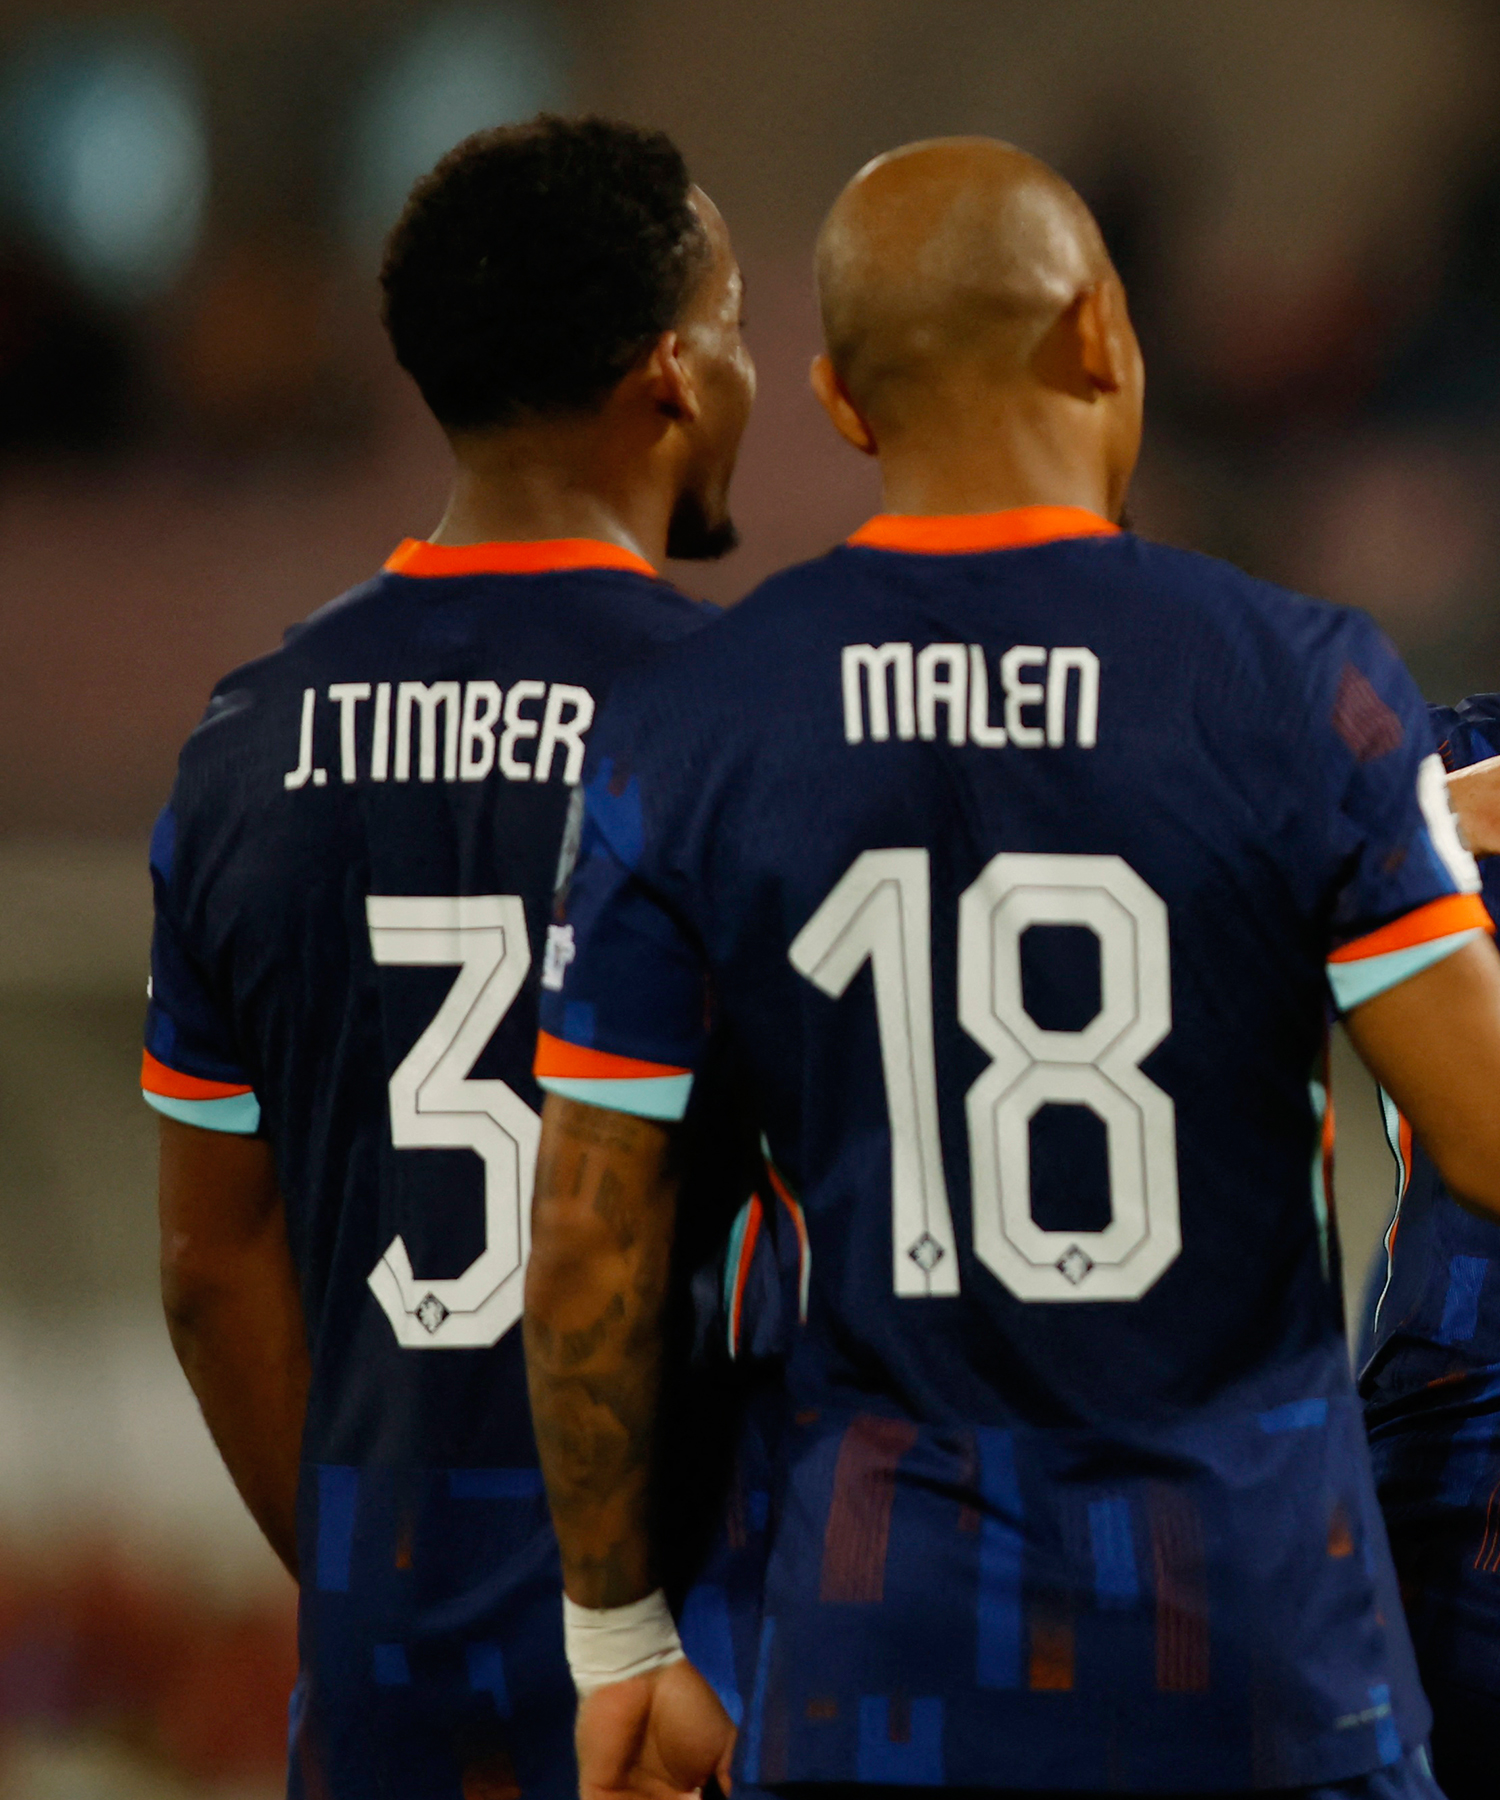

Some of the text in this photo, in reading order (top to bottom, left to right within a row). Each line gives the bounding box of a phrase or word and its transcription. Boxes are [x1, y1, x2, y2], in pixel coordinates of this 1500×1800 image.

[284, 680, 595, 789] J.TIMBER
[841, 642, 1100, 748] MALEN
[367, 895, 543, 1348] 3
[789, 848, 1181, 1302] 18
